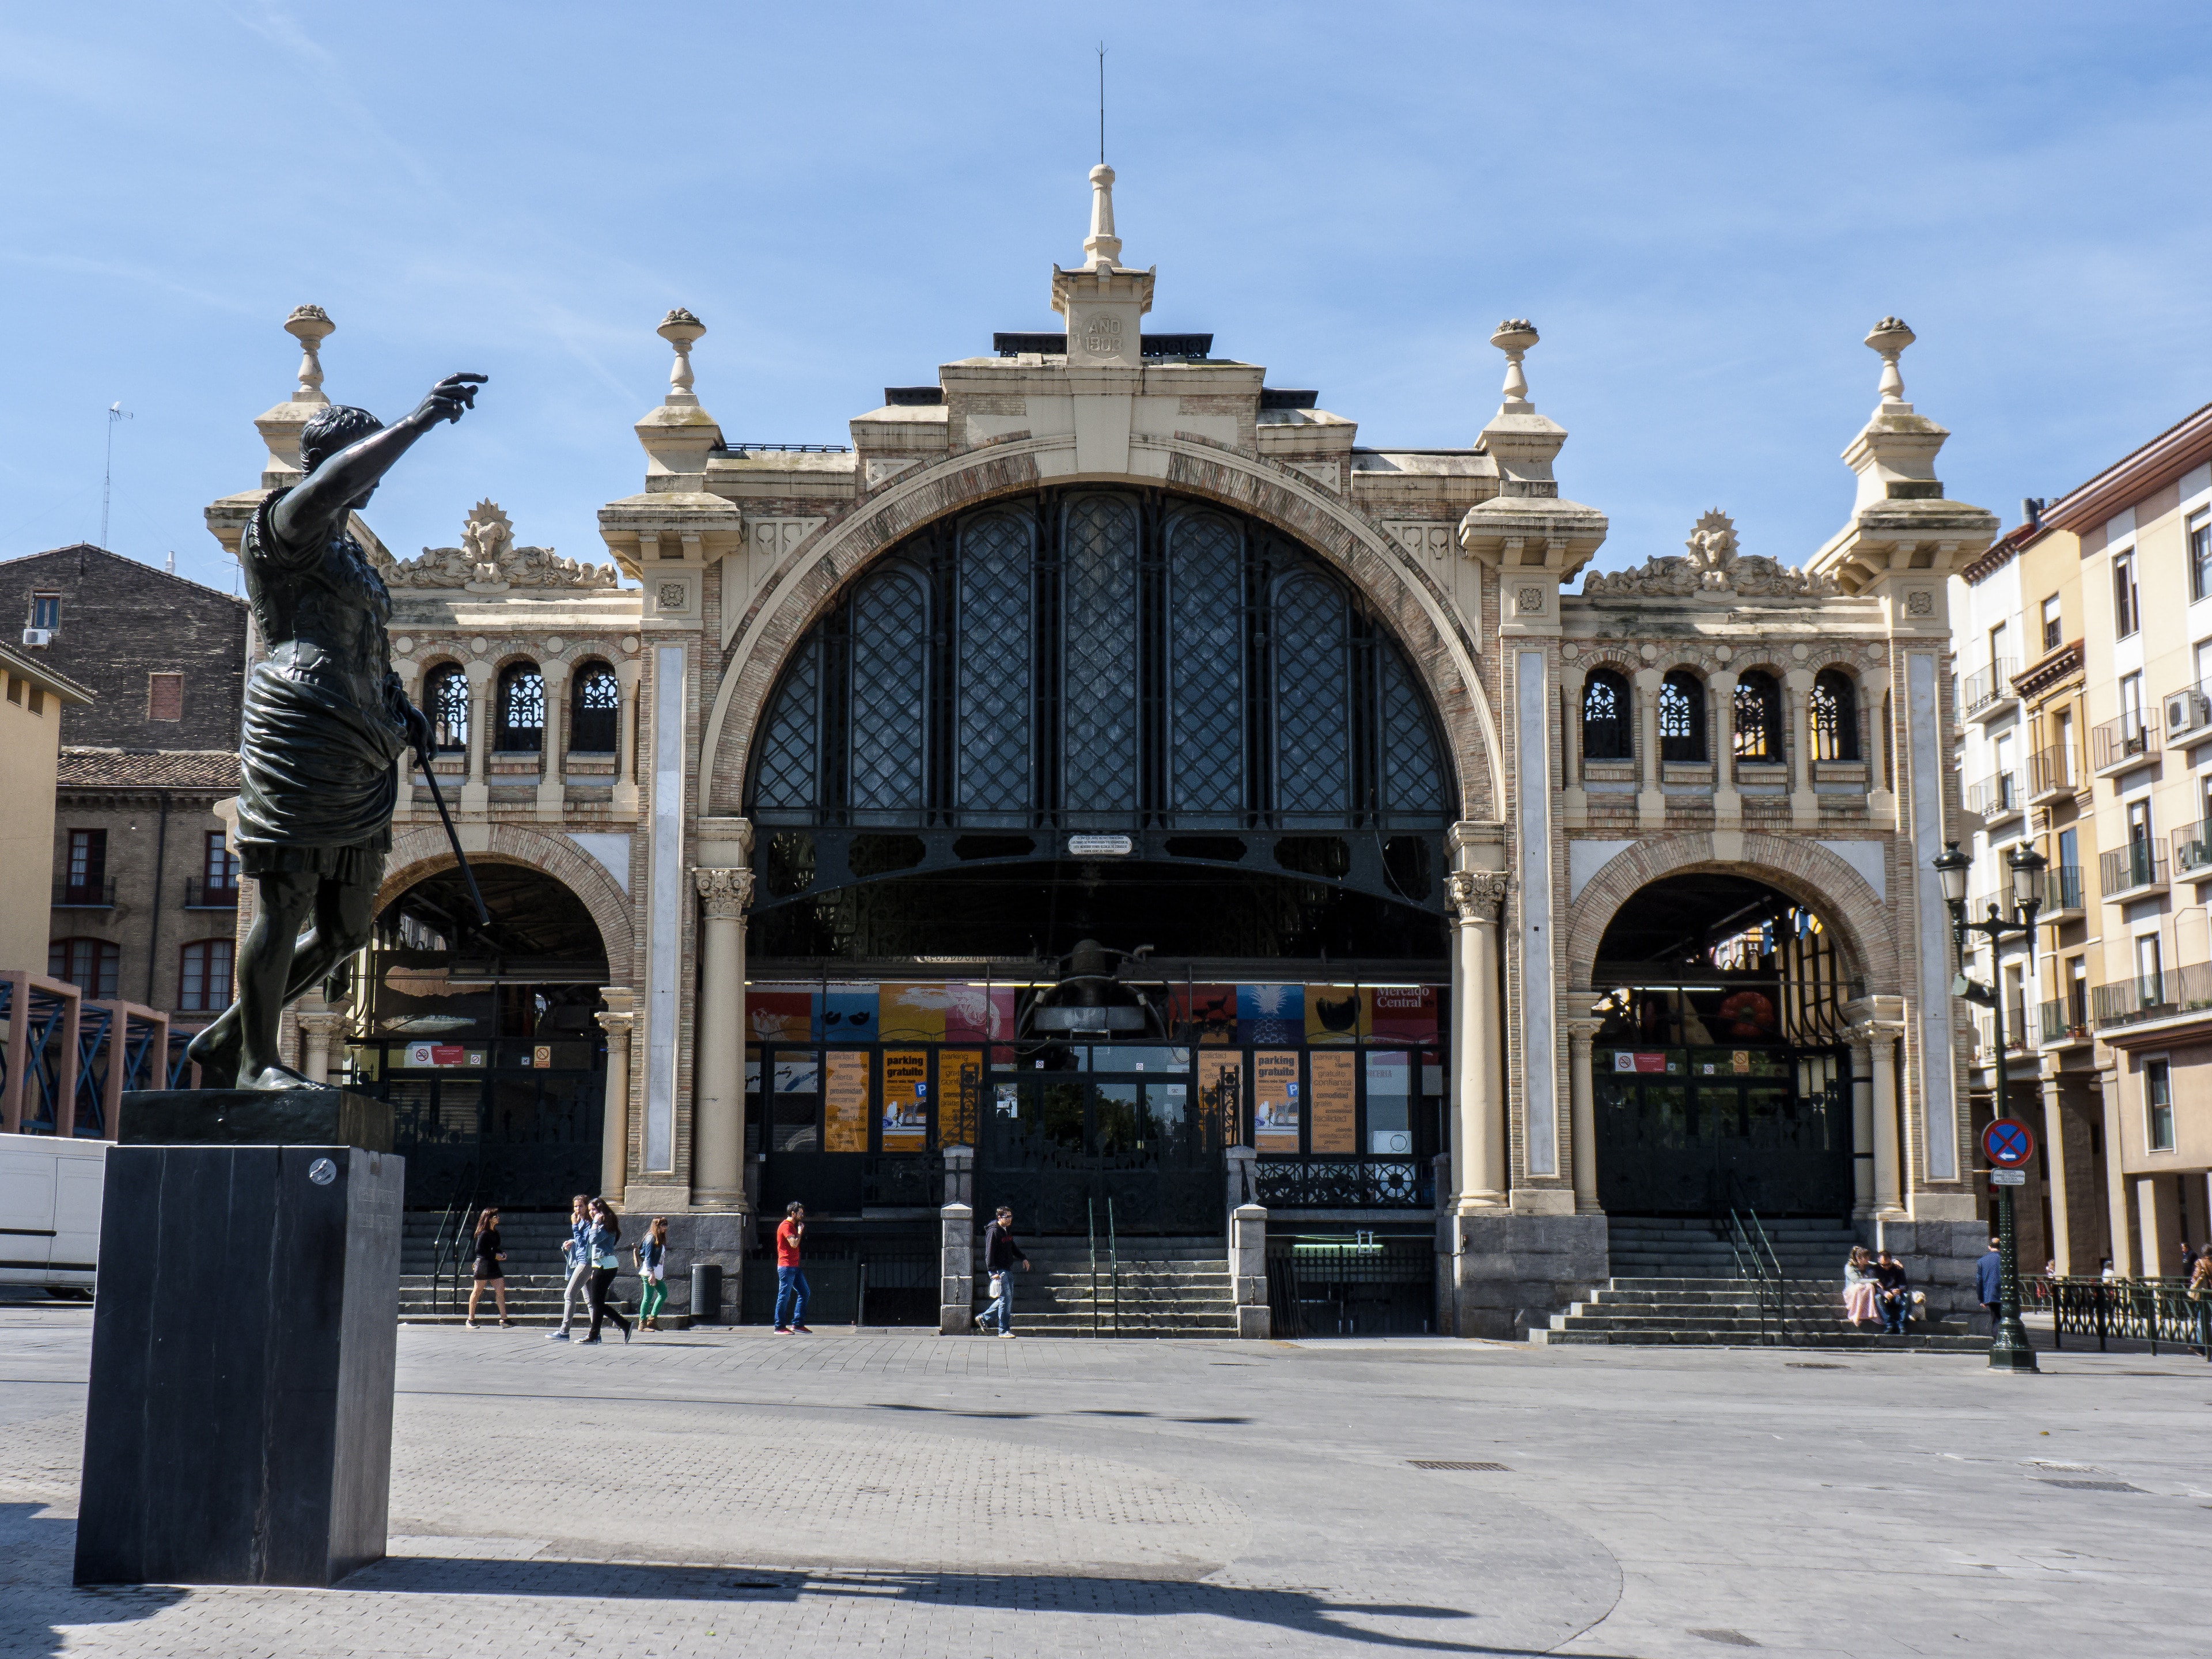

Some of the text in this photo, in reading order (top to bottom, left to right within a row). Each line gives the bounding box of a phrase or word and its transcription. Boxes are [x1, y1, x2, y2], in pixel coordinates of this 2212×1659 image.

[1377, 987, 1430, 996] Mercado
[1377, 996, 1422, 1007] Central
[887, 1056, 923, 1066] parking
[1258, 1055, 1294, 1066] parking
[887, 1067, 923, 1078] gratuito
[1258, 1067, 1294, 1077] gratuito
[918, 1085, 926, 1095] P
[1290, 1084, 1297, 1095] P
